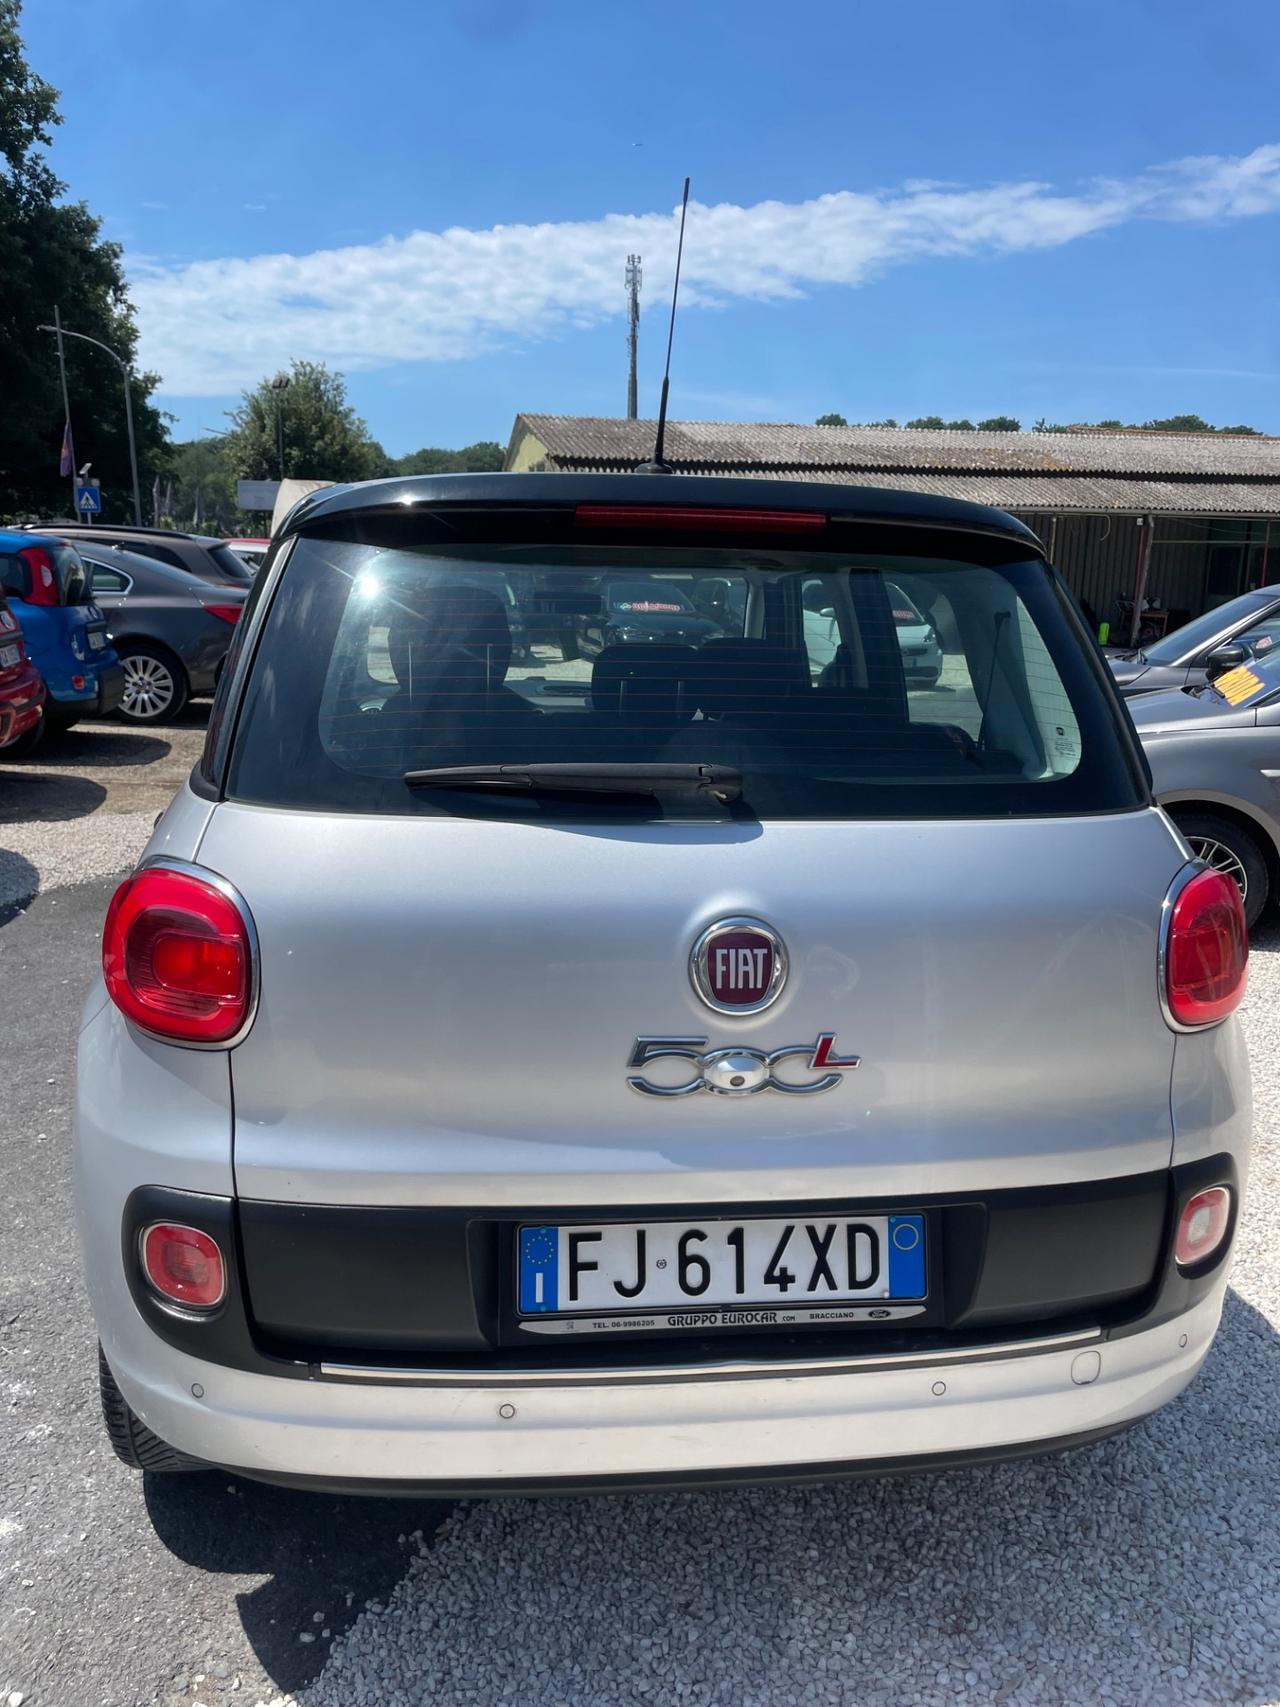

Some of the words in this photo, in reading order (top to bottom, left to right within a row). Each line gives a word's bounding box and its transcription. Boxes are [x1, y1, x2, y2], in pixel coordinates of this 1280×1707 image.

[715, 948, 768, 989] FIAT
[627, 1032, 862, 1098] 500L
[536, 1272, 544, 1303] I
[667, 1314, 718, 1327] GRUPPO
[721, 1312, 777, 1324] EUROCAR
[809, 1311, 854, 1320] BRACCIANO
